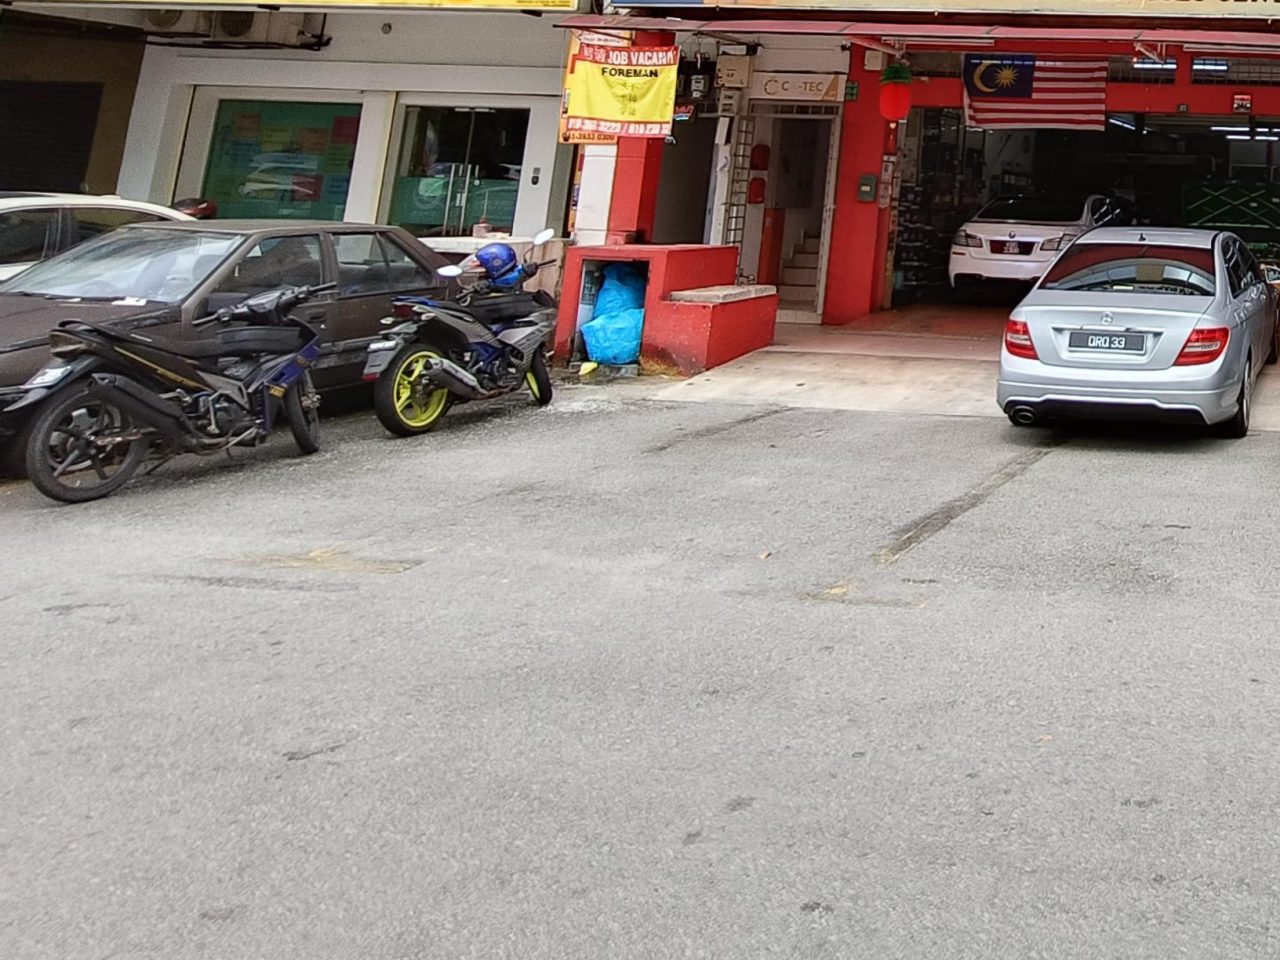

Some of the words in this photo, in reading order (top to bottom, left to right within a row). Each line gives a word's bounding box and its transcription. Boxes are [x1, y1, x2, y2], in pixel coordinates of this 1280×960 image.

[608, 50, 627, 64] JOB
[601, 67, 659, 78] FOREMAN
[1111, 337, 1125, 348] 33
